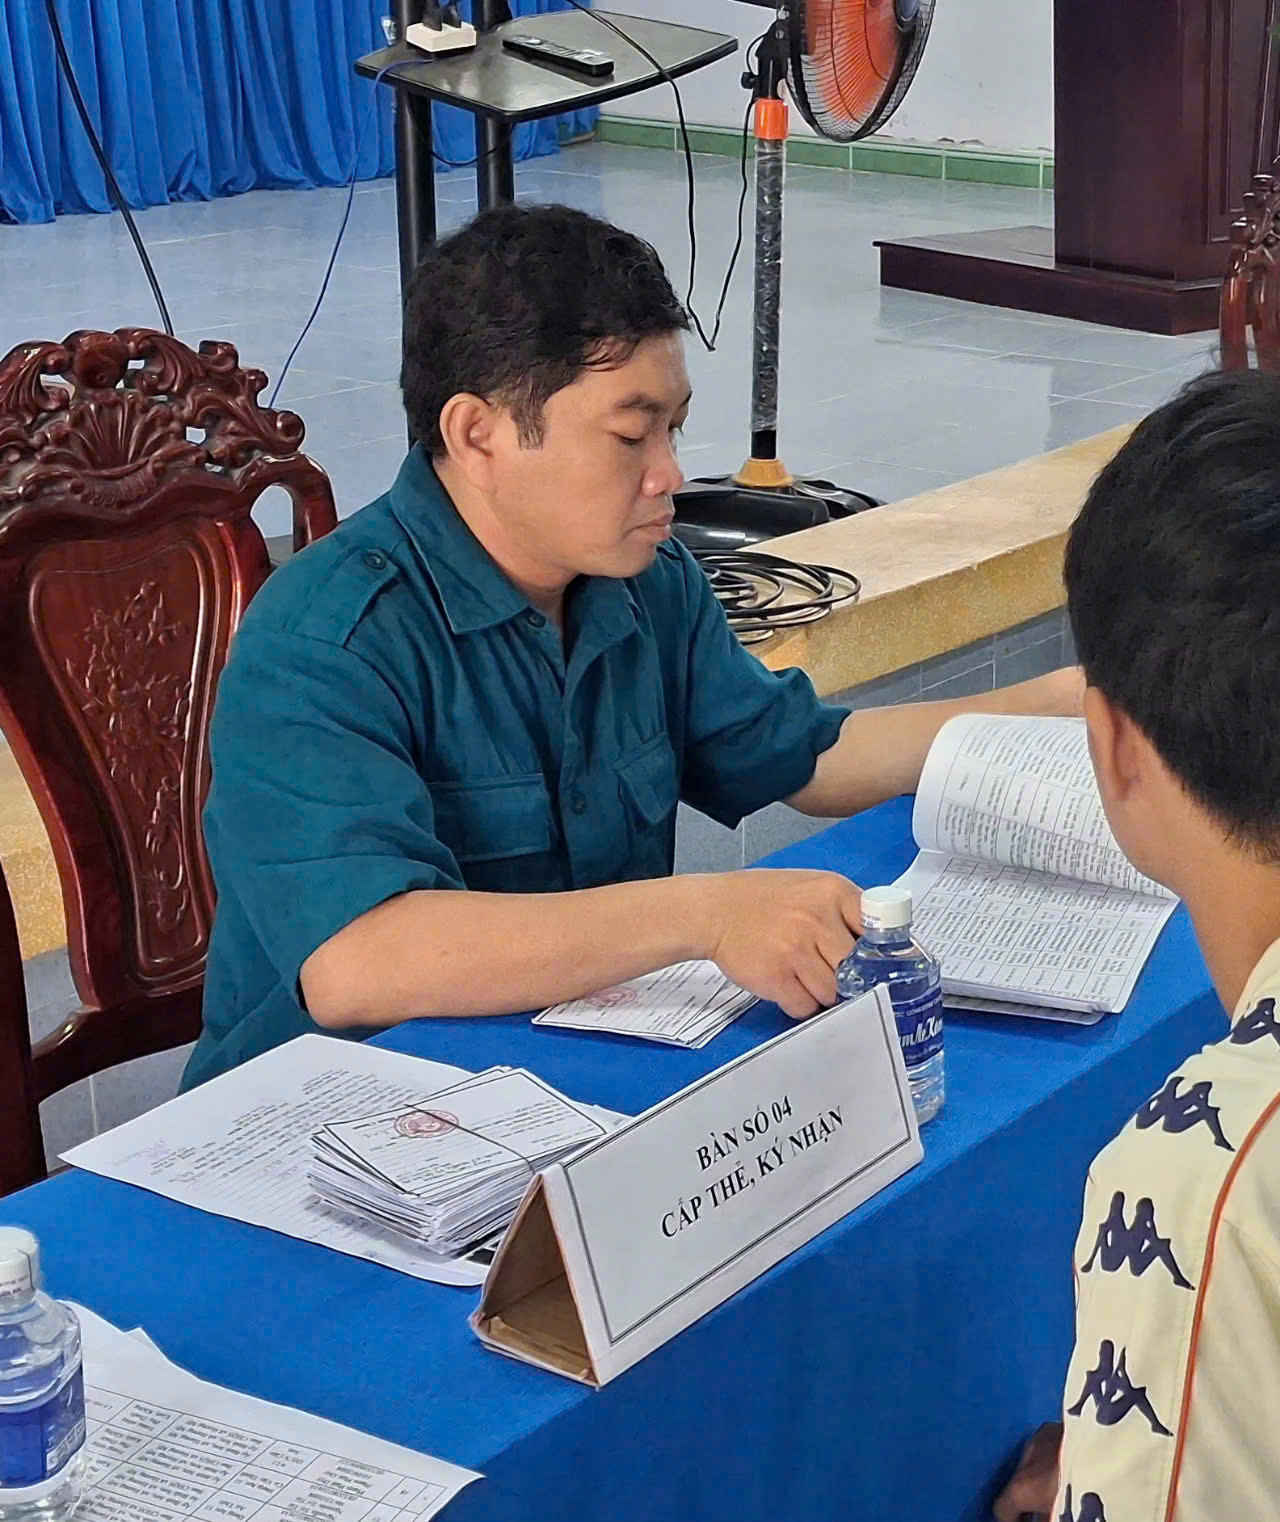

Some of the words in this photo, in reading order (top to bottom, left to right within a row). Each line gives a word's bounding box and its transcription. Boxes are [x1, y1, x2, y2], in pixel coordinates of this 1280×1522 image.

[660, 1196, 703, 1238] CẤP
[705, 1160, 756, 1208] THẺ,
[755, 1136, 785, 1177] KÝ
[787, 1105, 844, 1157] NHẬN
[695, 1127, 740, 1171] BÀN
[742, 1105, 770, 1142] SỐ
[771, 1095, 793, 1124] 04
